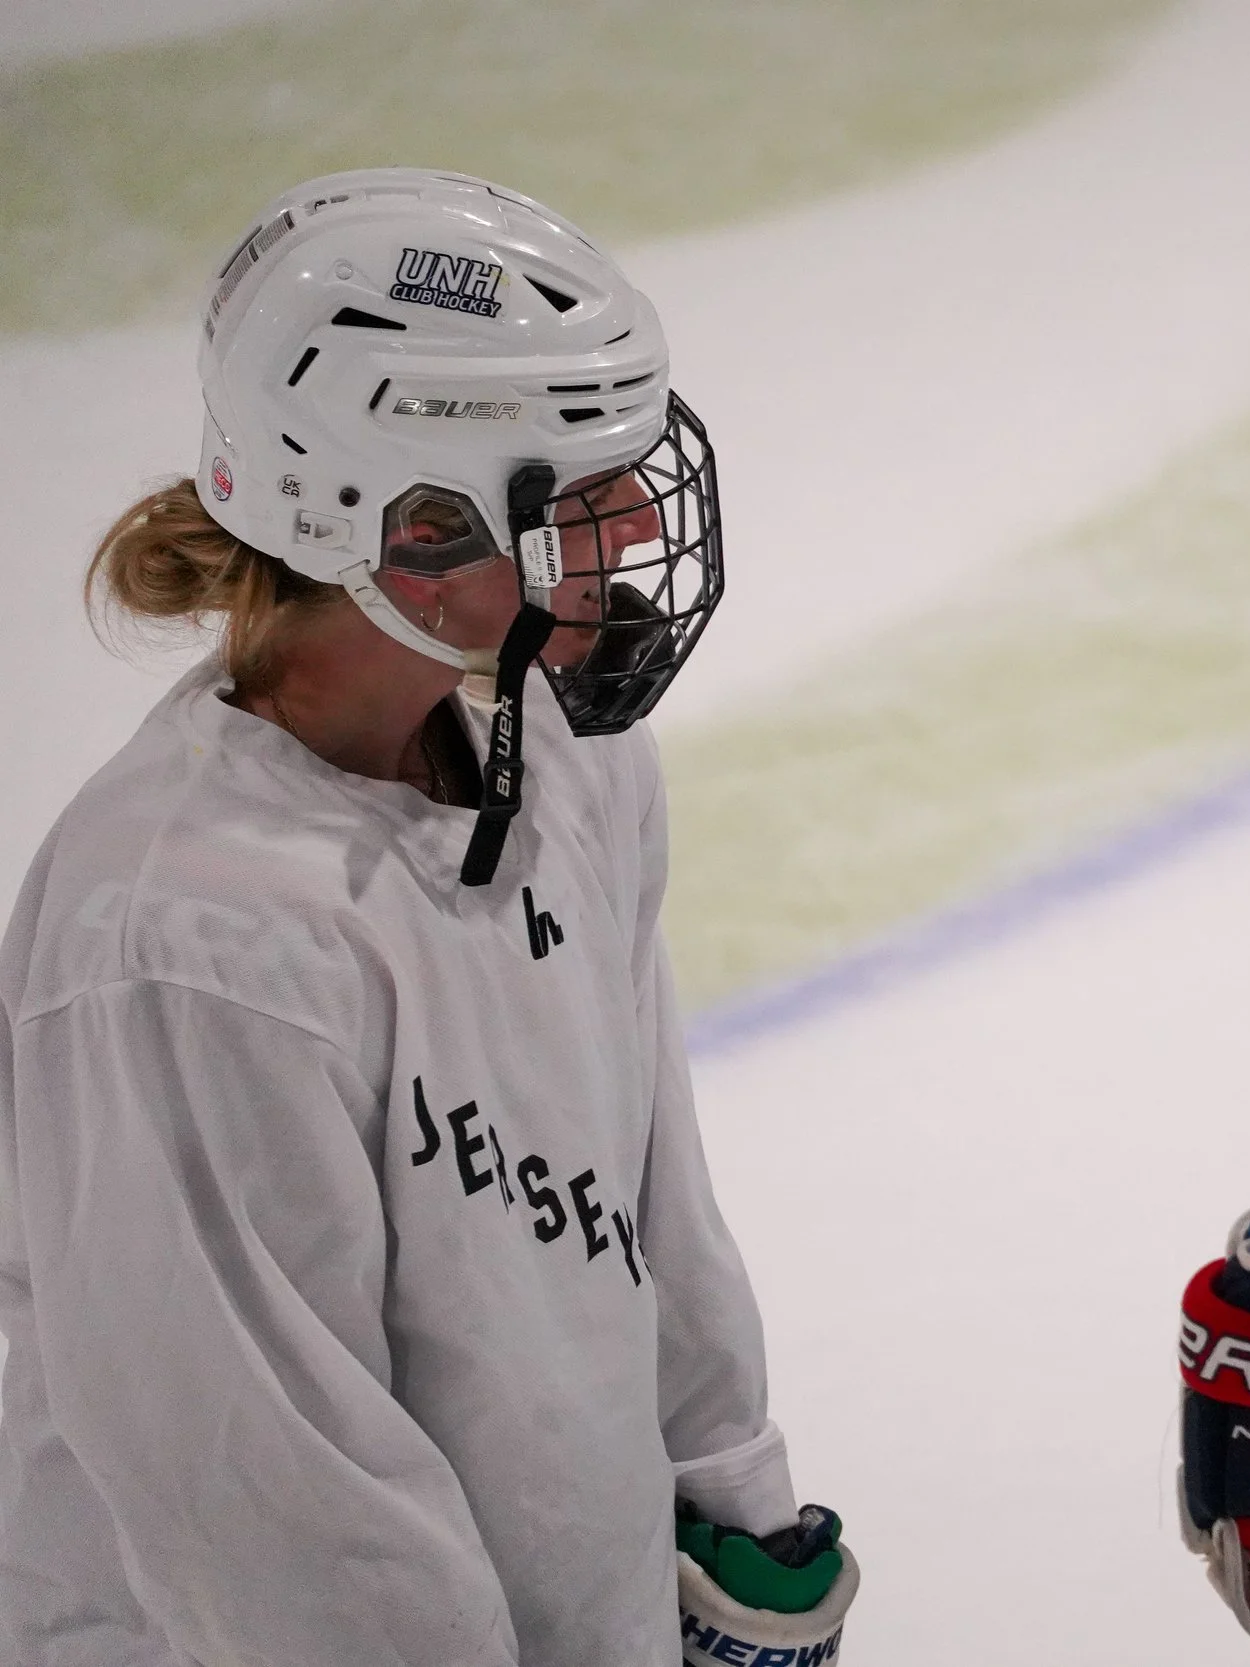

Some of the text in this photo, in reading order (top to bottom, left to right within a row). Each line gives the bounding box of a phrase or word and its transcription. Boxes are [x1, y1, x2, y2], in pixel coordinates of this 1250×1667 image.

[396, 248, 502, 301] UNH
[390, 284, 501, 318] CLUB HOCKEY
[392, 397, 521, 420] BAUER
[543, 530, 557, 583] BAUER
